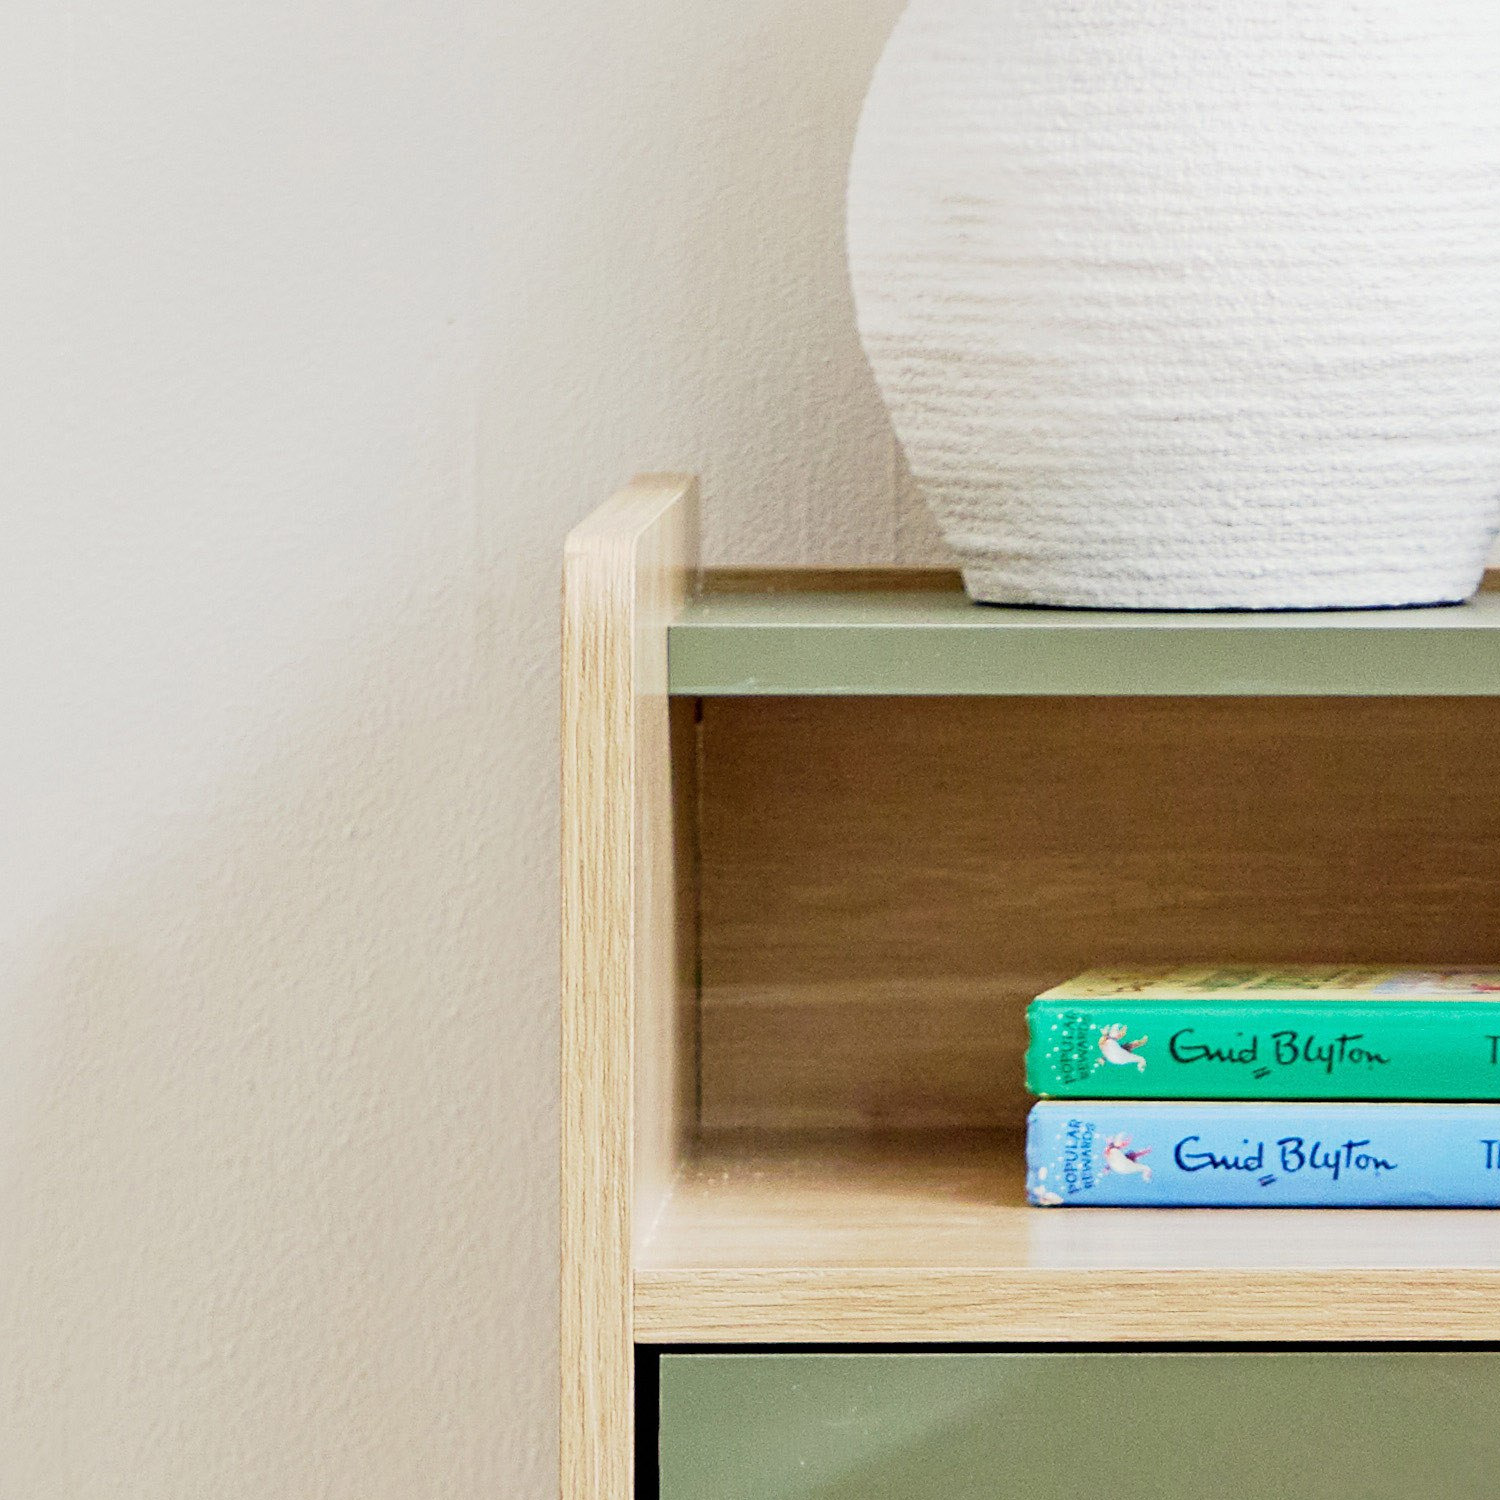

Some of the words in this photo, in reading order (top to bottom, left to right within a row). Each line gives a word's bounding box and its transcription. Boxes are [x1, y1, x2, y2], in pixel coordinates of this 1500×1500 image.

[1169, 1028, 1258, 1065] Enid
[1271, 1030, 1391, 1074] Blyton
[1174, 1136, 1262, 1172] Enid
[1277, 1138, 1398, 1180] Blyton
